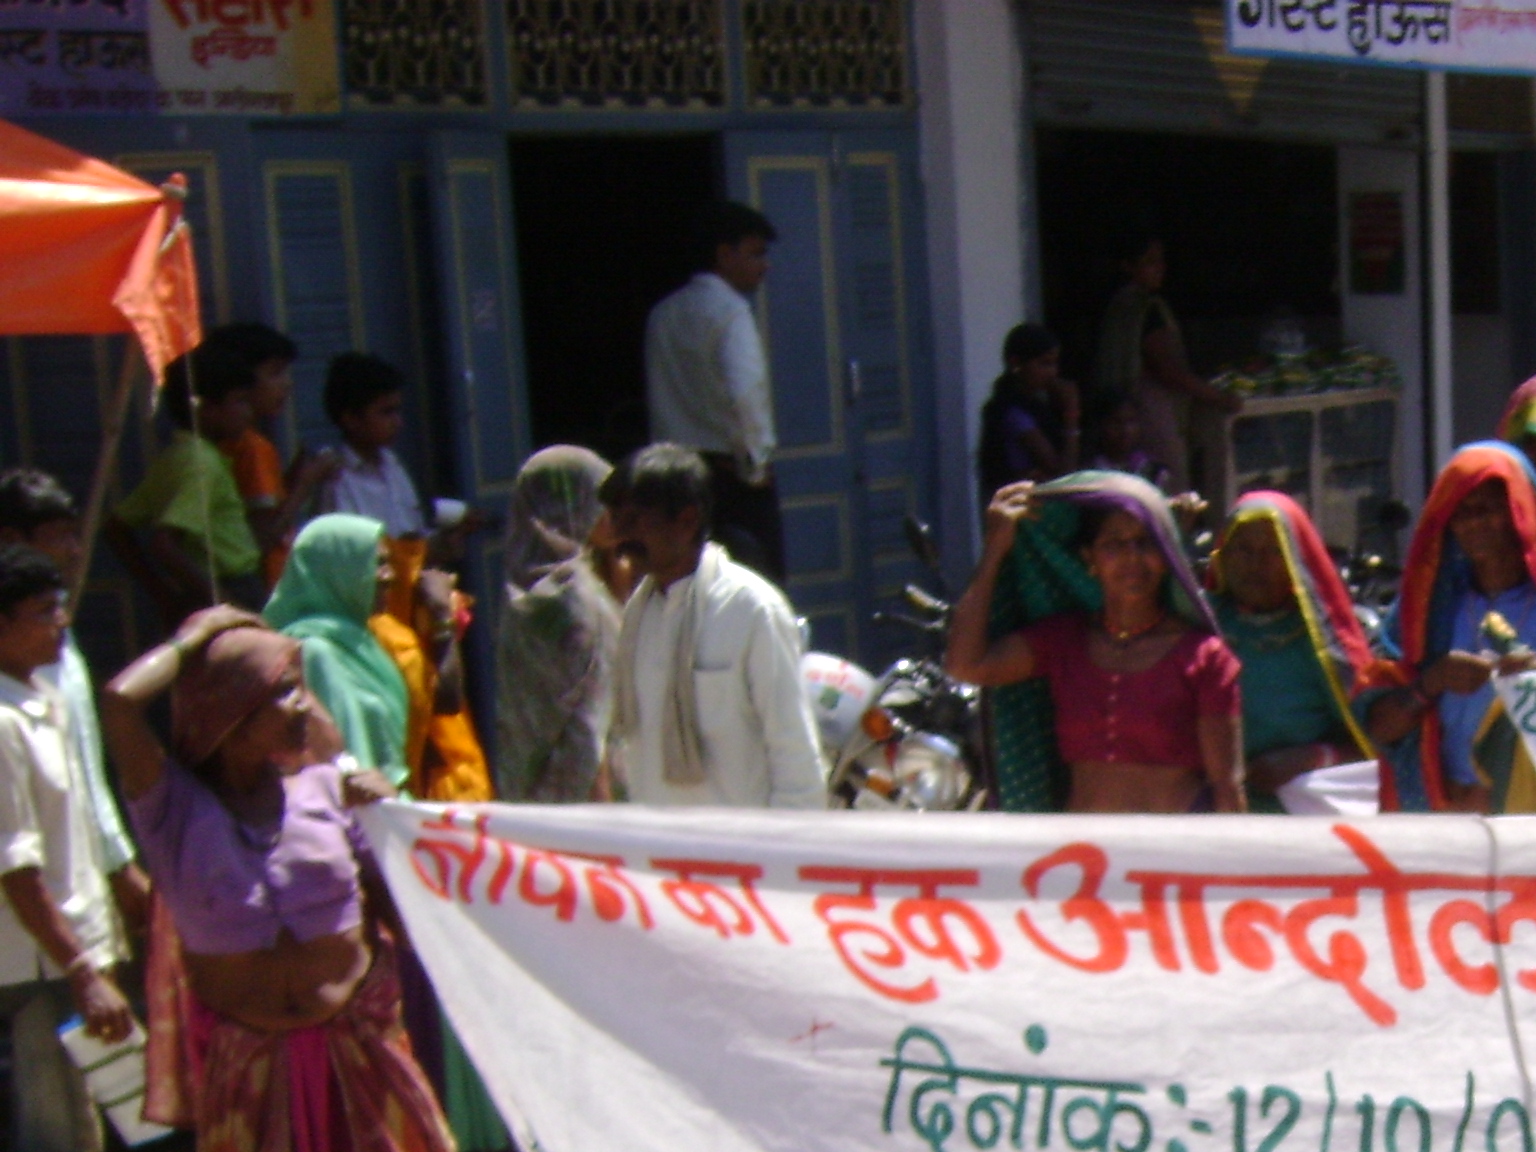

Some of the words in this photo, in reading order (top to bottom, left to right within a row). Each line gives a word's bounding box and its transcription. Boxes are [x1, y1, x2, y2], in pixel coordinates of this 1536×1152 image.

[1346, 1, 1448, 54] हाऊस
[649, 857, 790, 945] का
[798, 864, 1002, 1003] हक
